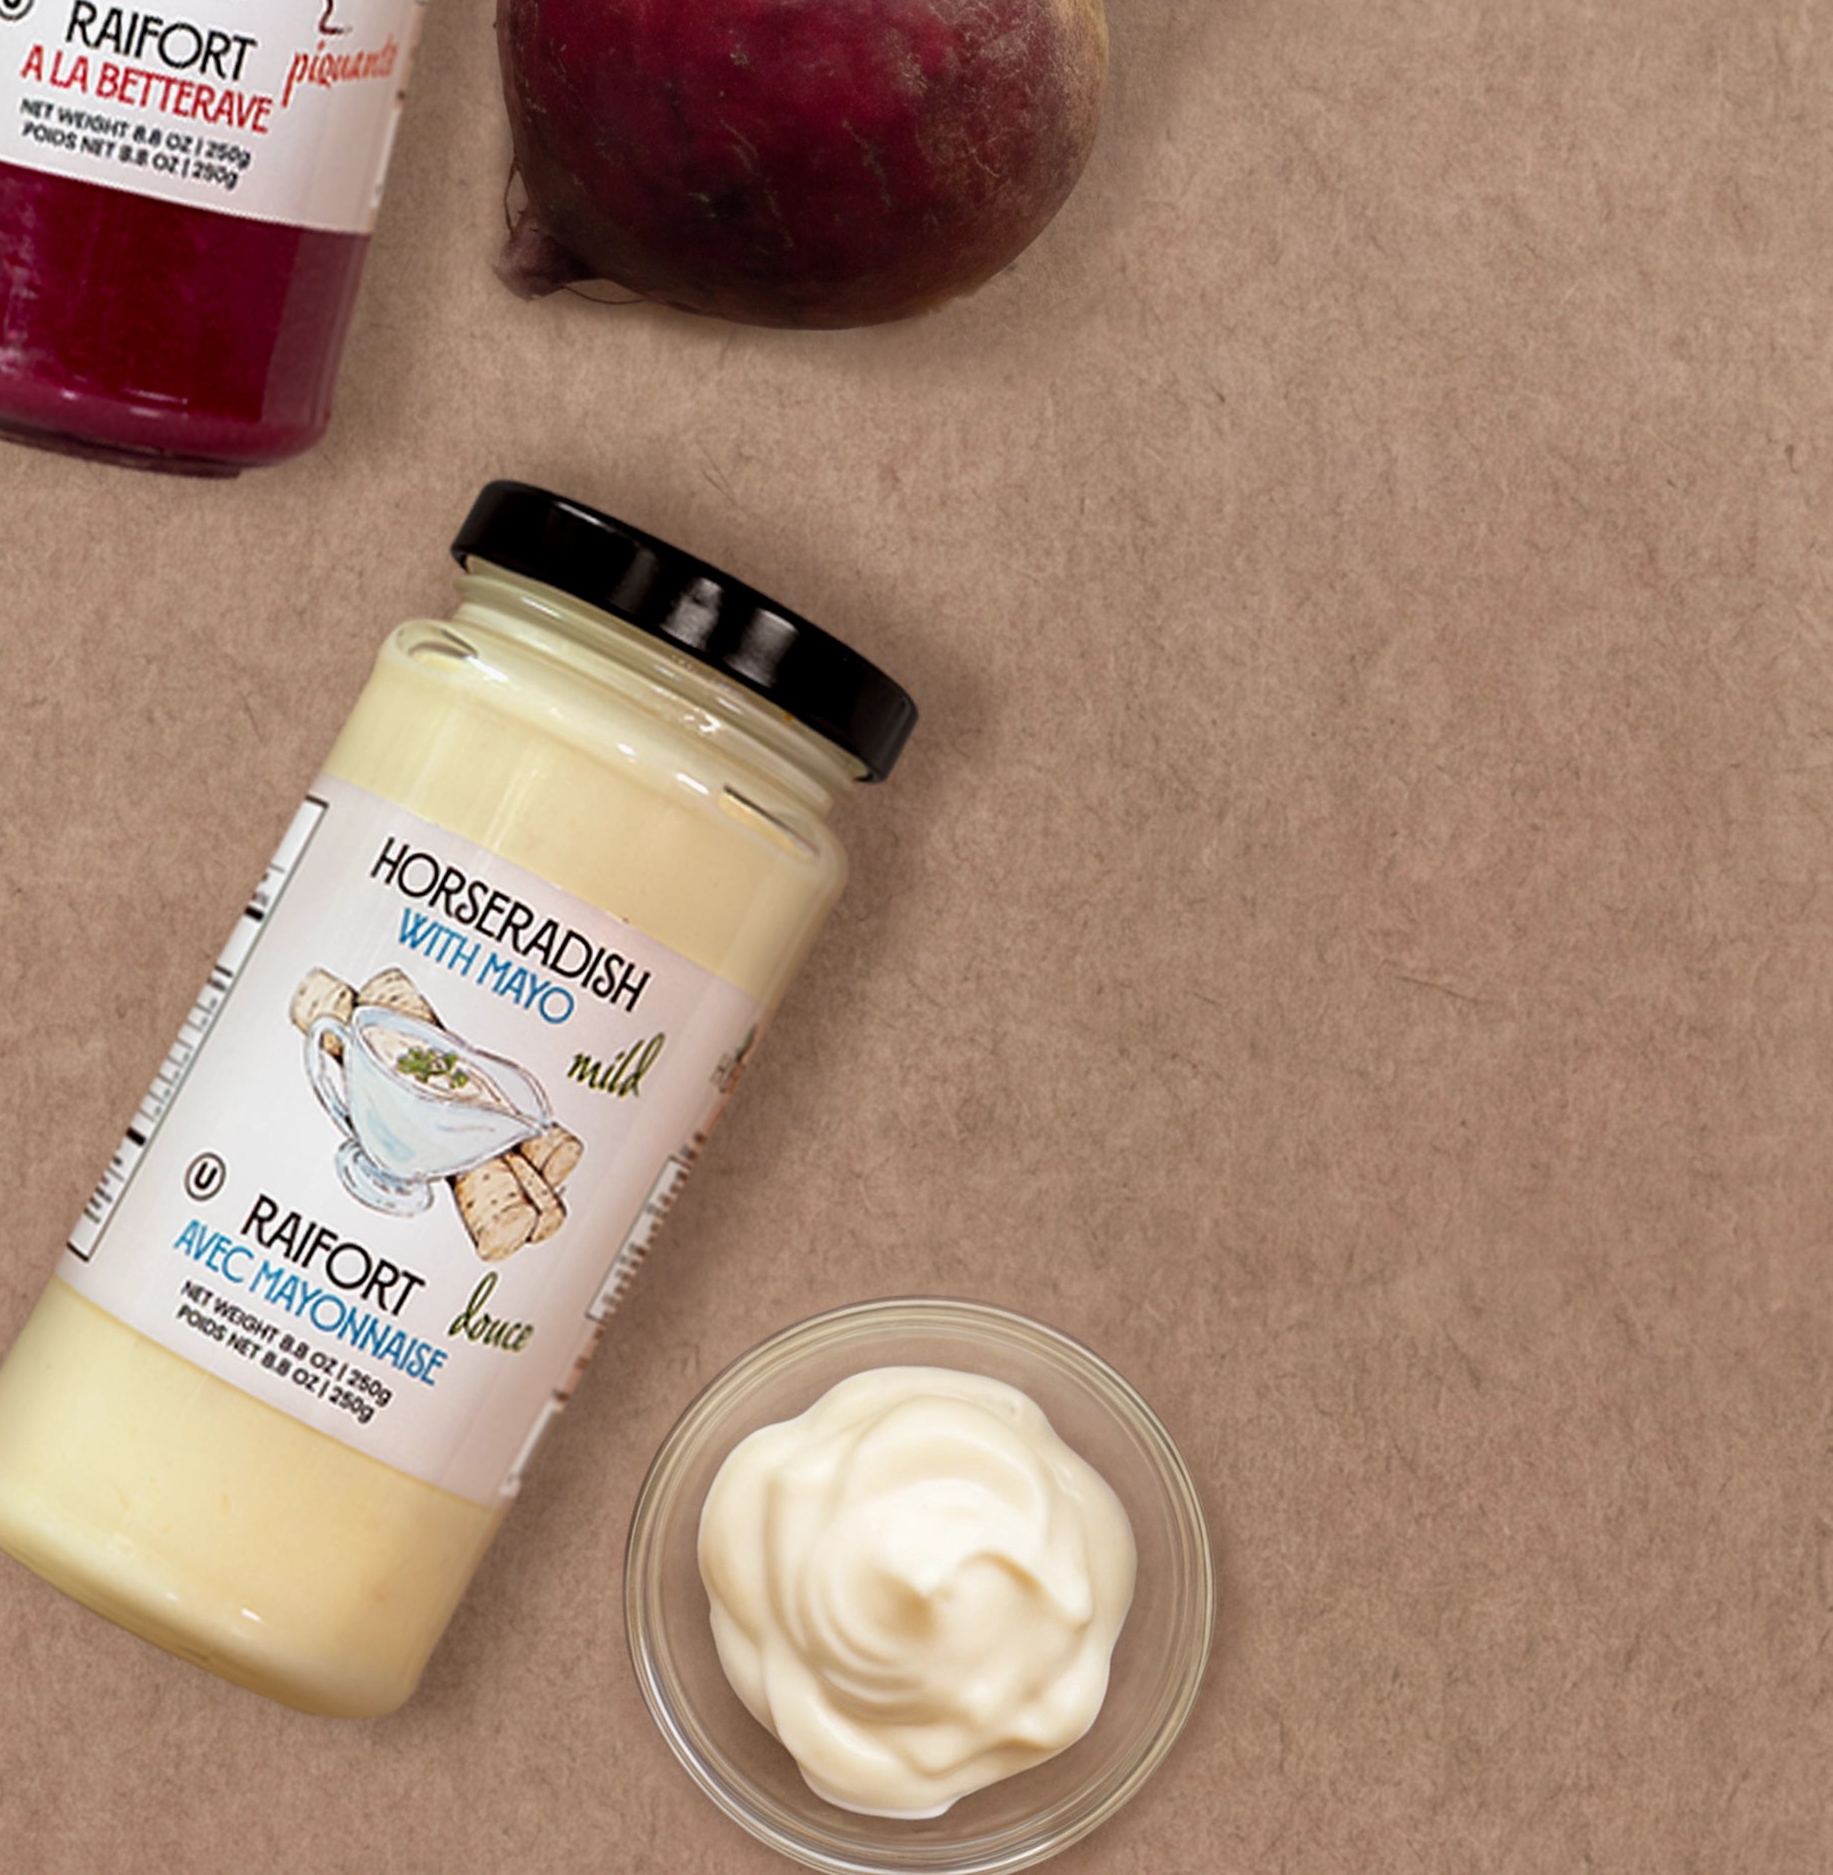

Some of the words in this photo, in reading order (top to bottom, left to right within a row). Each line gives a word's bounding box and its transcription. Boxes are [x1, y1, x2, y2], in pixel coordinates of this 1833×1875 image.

[20, 98, 54, 119] NET
[58, 107, 129, 139] WEIGHT
[166, 133, 192, 155] OZ
[205, 140, 251, 169] 250g
[21, 43, 46, 80] A
[49, 49, 90, 93] LA
[95, 64, 272, 134] BETTERAVE
[22, 121, 77, 150] POIDS
[81, 136, 115, 157] NET
[152, 152, 179, 174] OZ
[192, 161, 238, 190] 250g
[369, 836, 652, 1013] HORSERADISH
[397, 907, 479, 976] WITH
[475, 955, 575, 1025] MAYO
[567, 1033, 666, 1098] mild
[172, 1219, 250, 1287] AVEC
[253, 1261, 449, 1387] MAYONNAISE
[241, 1193, 426, 1319] RAIFORT
[448, 1272, 535, 1352] douce
[177, 1304, 227, 1342] POIDS
[227, 1333, 261, 1360] NET
[292, 1369, 320, 1392] OZ
[329, 1386, 375, 1424] 250g
[181, 1280, 213, 1306] NET
[214, 1298, 280, 1343] WEIGHT
[310, 1352, 338, 1376] OZ
[346, 1369, 392, 1407] 250g
